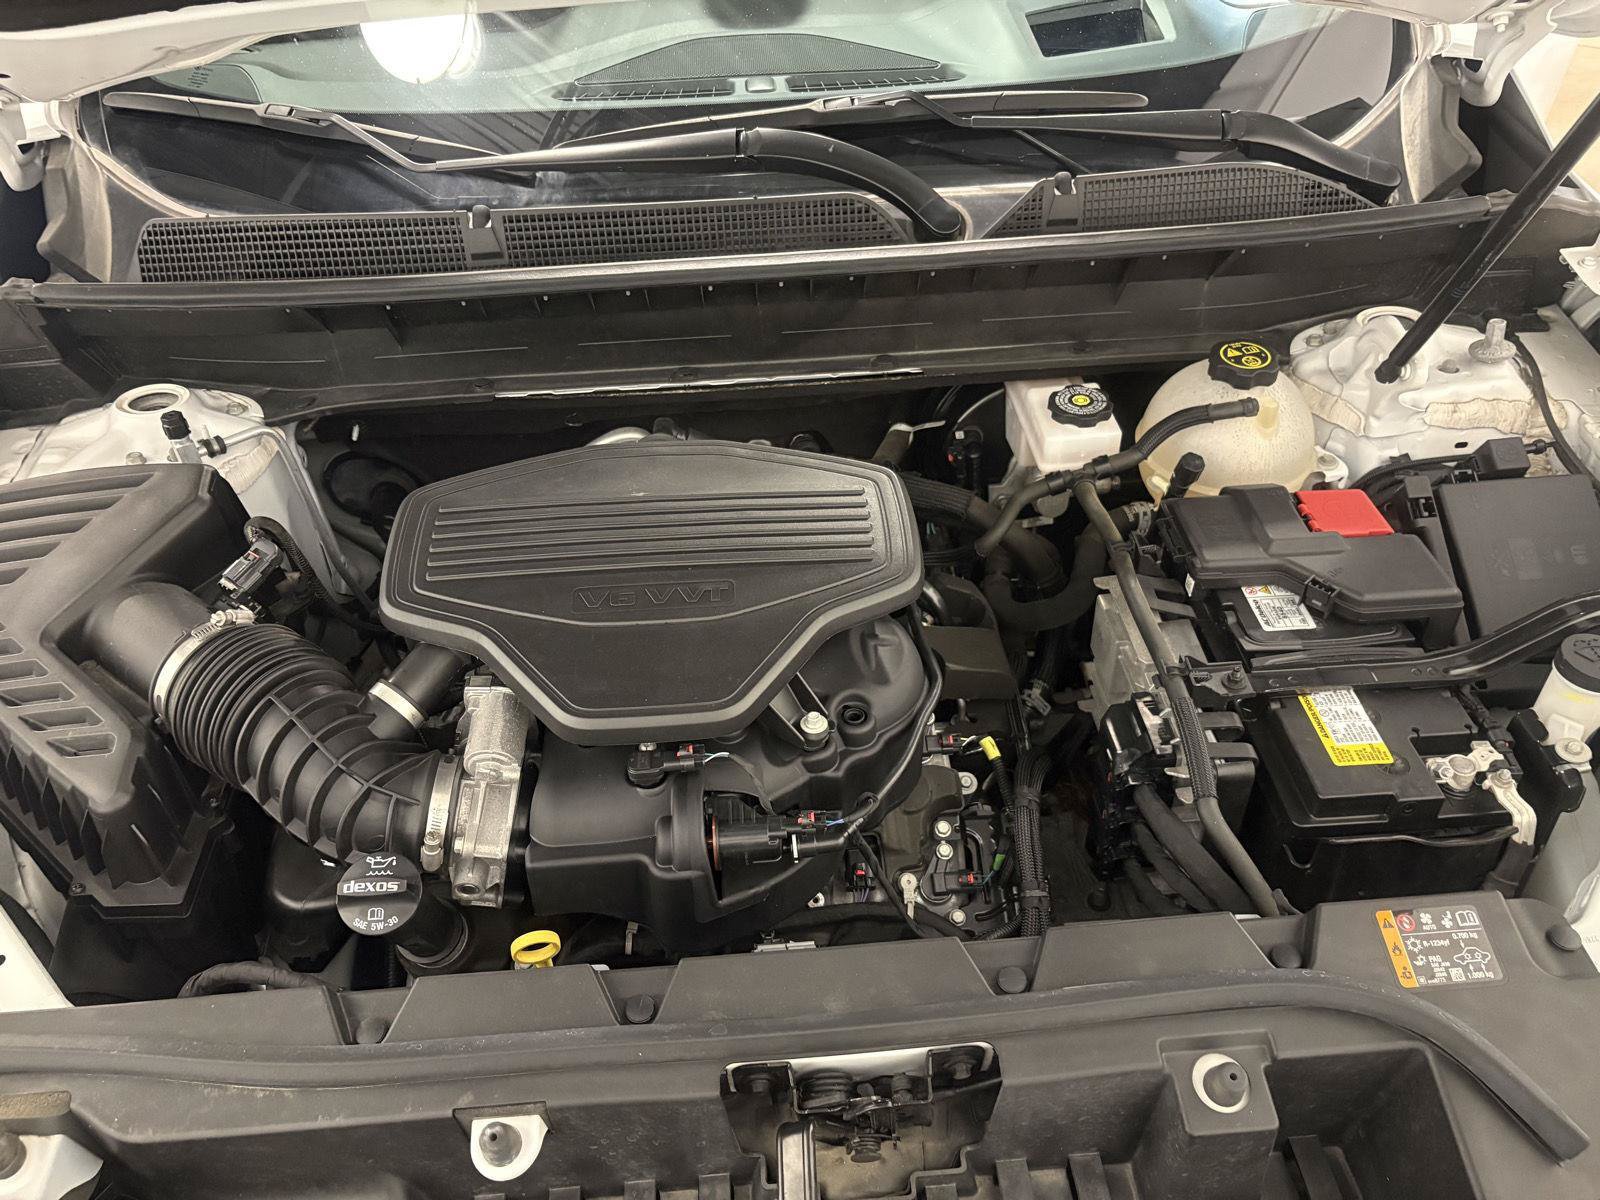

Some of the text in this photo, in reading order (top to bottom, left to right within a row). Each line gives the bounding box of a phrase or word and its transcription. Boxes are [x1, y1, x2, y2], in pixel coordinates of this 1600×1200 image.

[578, 584, 730, 608] V6 VVT
[343, 880, 400, 894] dexos
[353, 915, 399, 931] SAE 5W-30
[1469, 931, 1479, 940] kg
[1423, 938, 1451, 948] R-1234yf
